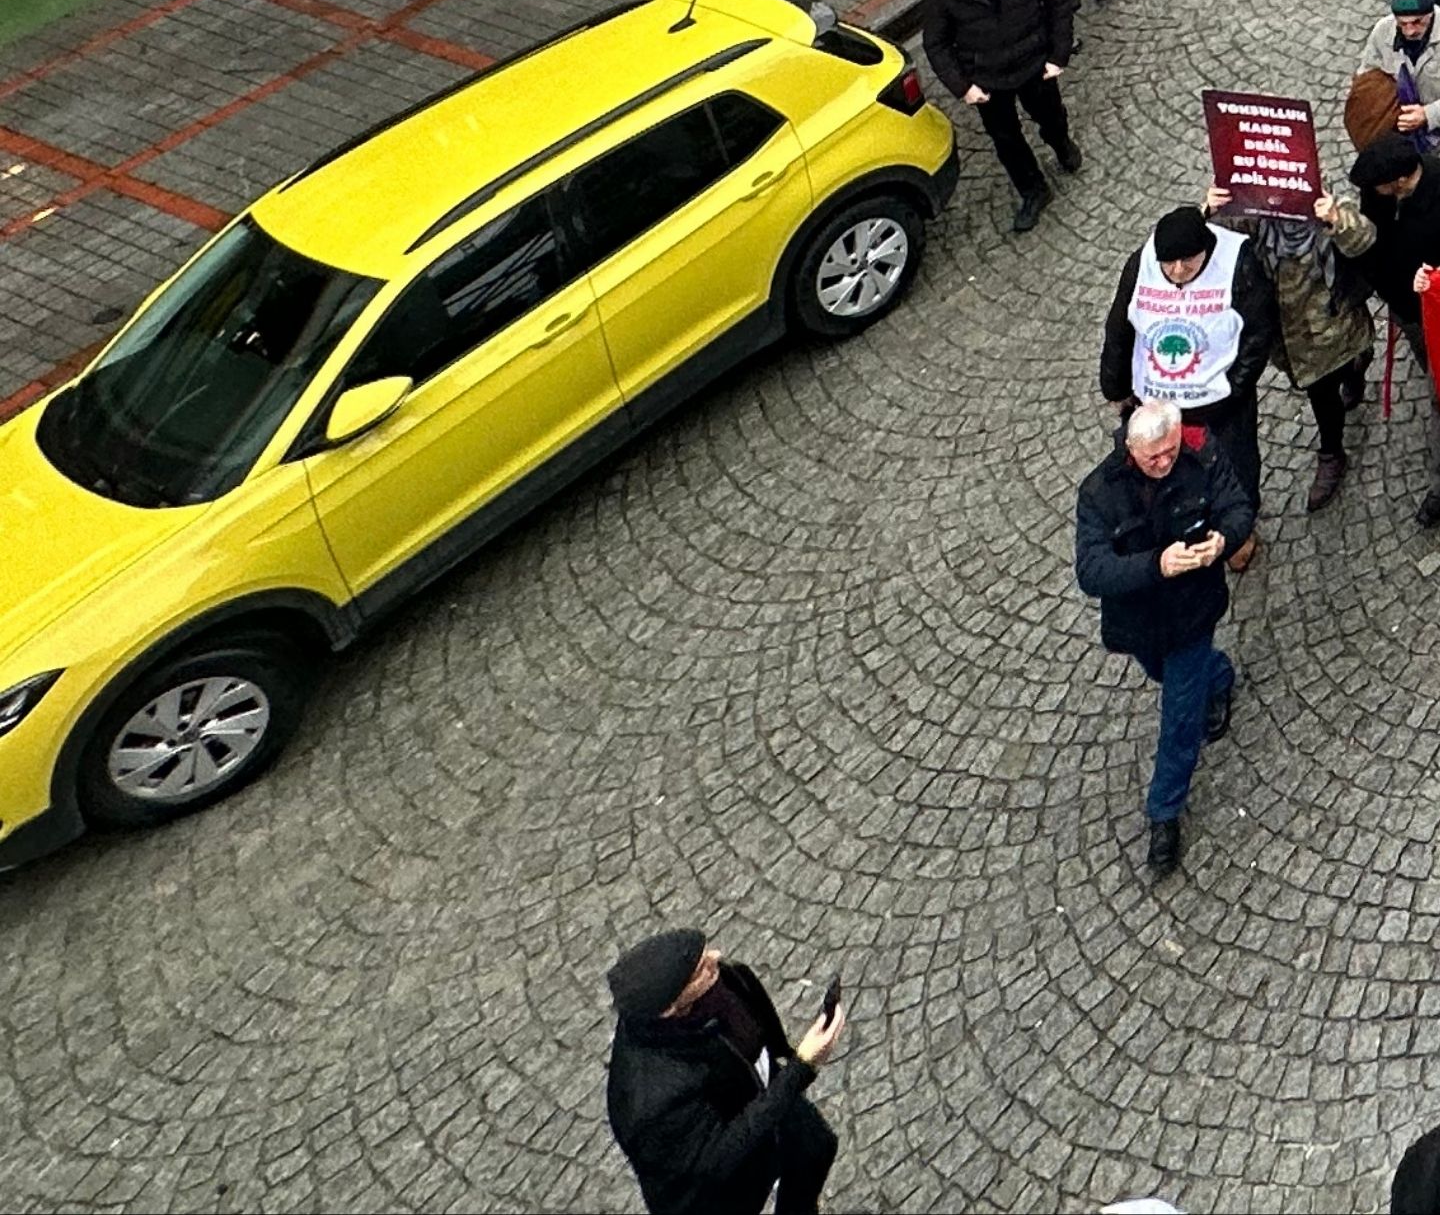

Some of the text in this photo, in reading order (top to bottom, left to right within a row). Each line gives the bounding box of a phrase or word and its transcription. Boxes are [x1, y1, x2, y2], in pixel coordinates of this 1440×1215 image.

[1217, 102, 1308, 122] YOKSULLUK
[1239, 121, 1292, 137] KADER
[1244, 138, 1290, 154] DEĞİL
[1233, 154, 1308, 173] BU ÜCRET
[1230, 171, 1313, 192] ADİL DEĞİL
